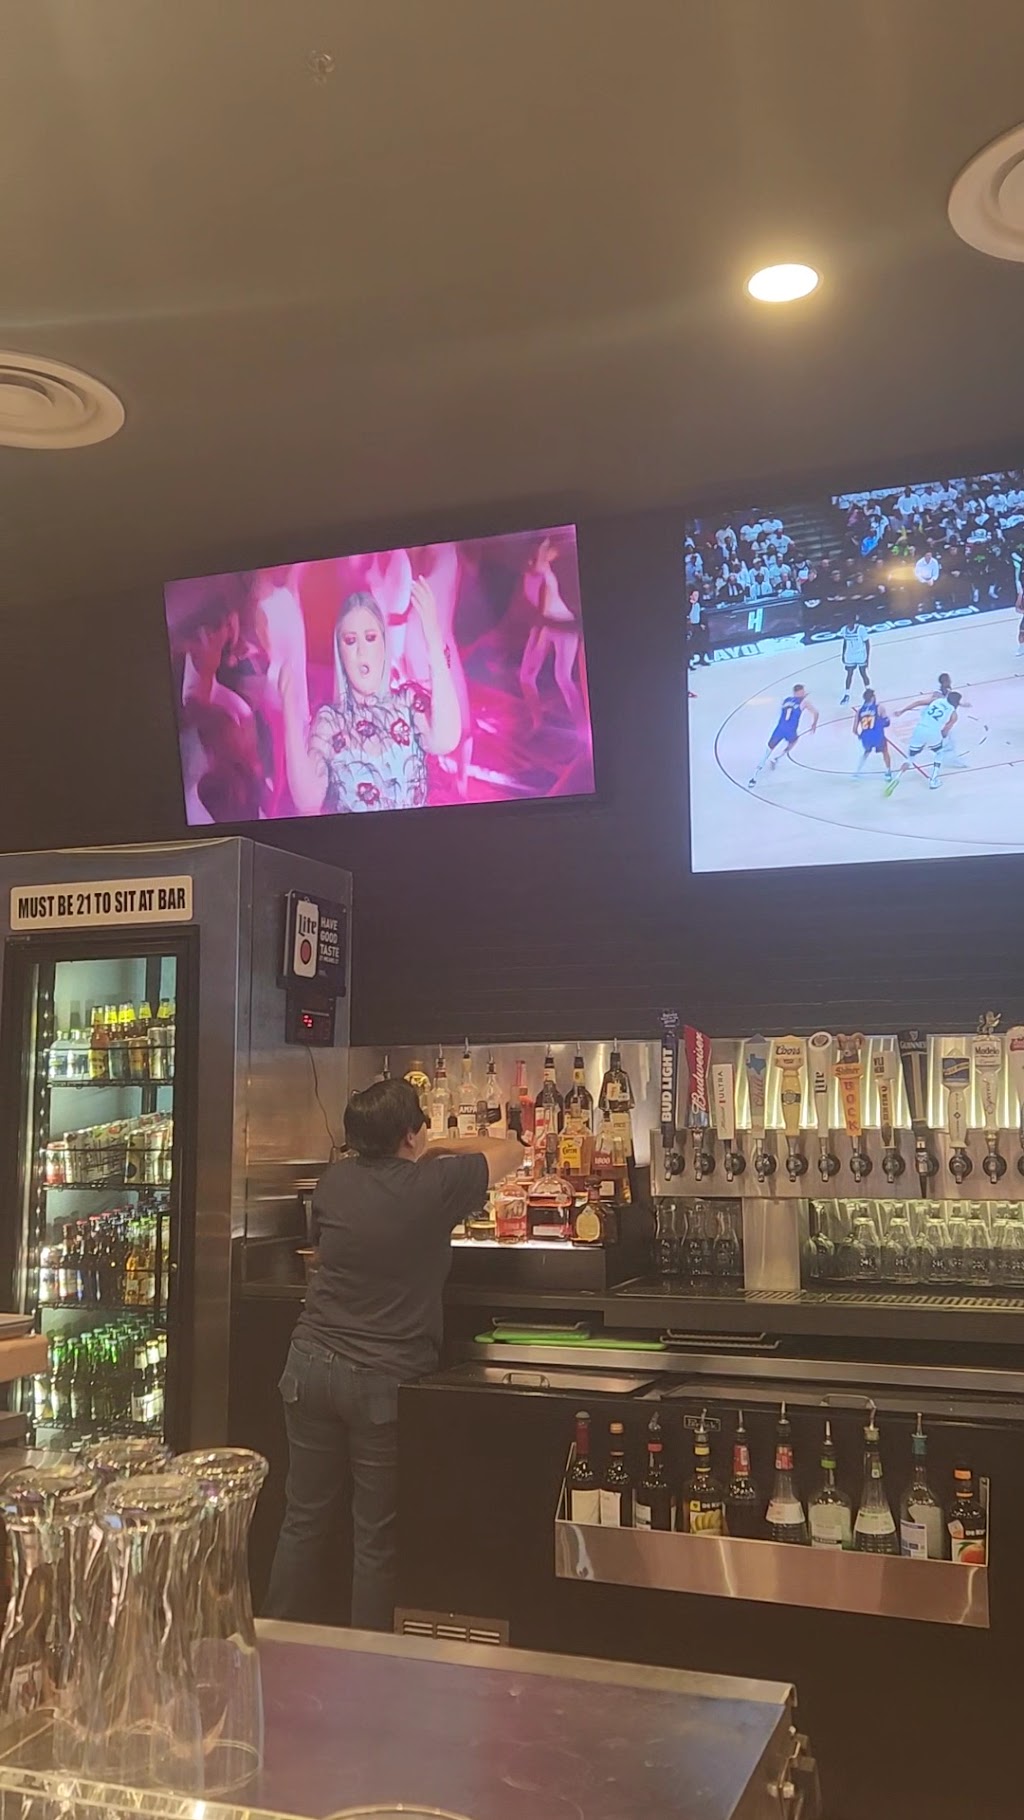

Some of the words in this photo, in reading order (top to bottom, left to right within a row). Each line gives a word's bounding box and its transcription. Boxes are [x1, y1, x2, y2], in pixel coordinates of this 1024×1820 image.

[747, 608, 763, 633] H
[915, 605, 980, 623] Pixel
[927, 705, 944, 721] 32
[18, 896, 55, 919] MUST
[57, 894, 74, 916] BE
[76, 893, 91, 915] 21
[94, 892, 111, 914] TO
[115, 890, 136, 913] SIT
[138, 889, 155, 911] AT
[158, 887, 186, 910] BAR
[298, 914, 317, 937] Lite
[320, 916, 338, 931] HAVE
[320, 930, 338, 944] GOOD
[319, 943, 340, 958] TASTE
[775, 1045, 800, 1056] Coors
[975, 1046, 1000, 1055] Modelo
[661, 1047, 674, 1090] LIGHT
[691, 1031, 707, 1114] Budweiser
[717, 1071, 725, 1098] ULTRA
[815, 1072, 827, 1093] Lite
[459, 1105, 478, 1114] AMPA
[661, 1091, 673, 1122] BUD
[843, 1081, 858, 1131] BOCK
[594, 1157, 611, 1165] 1800
